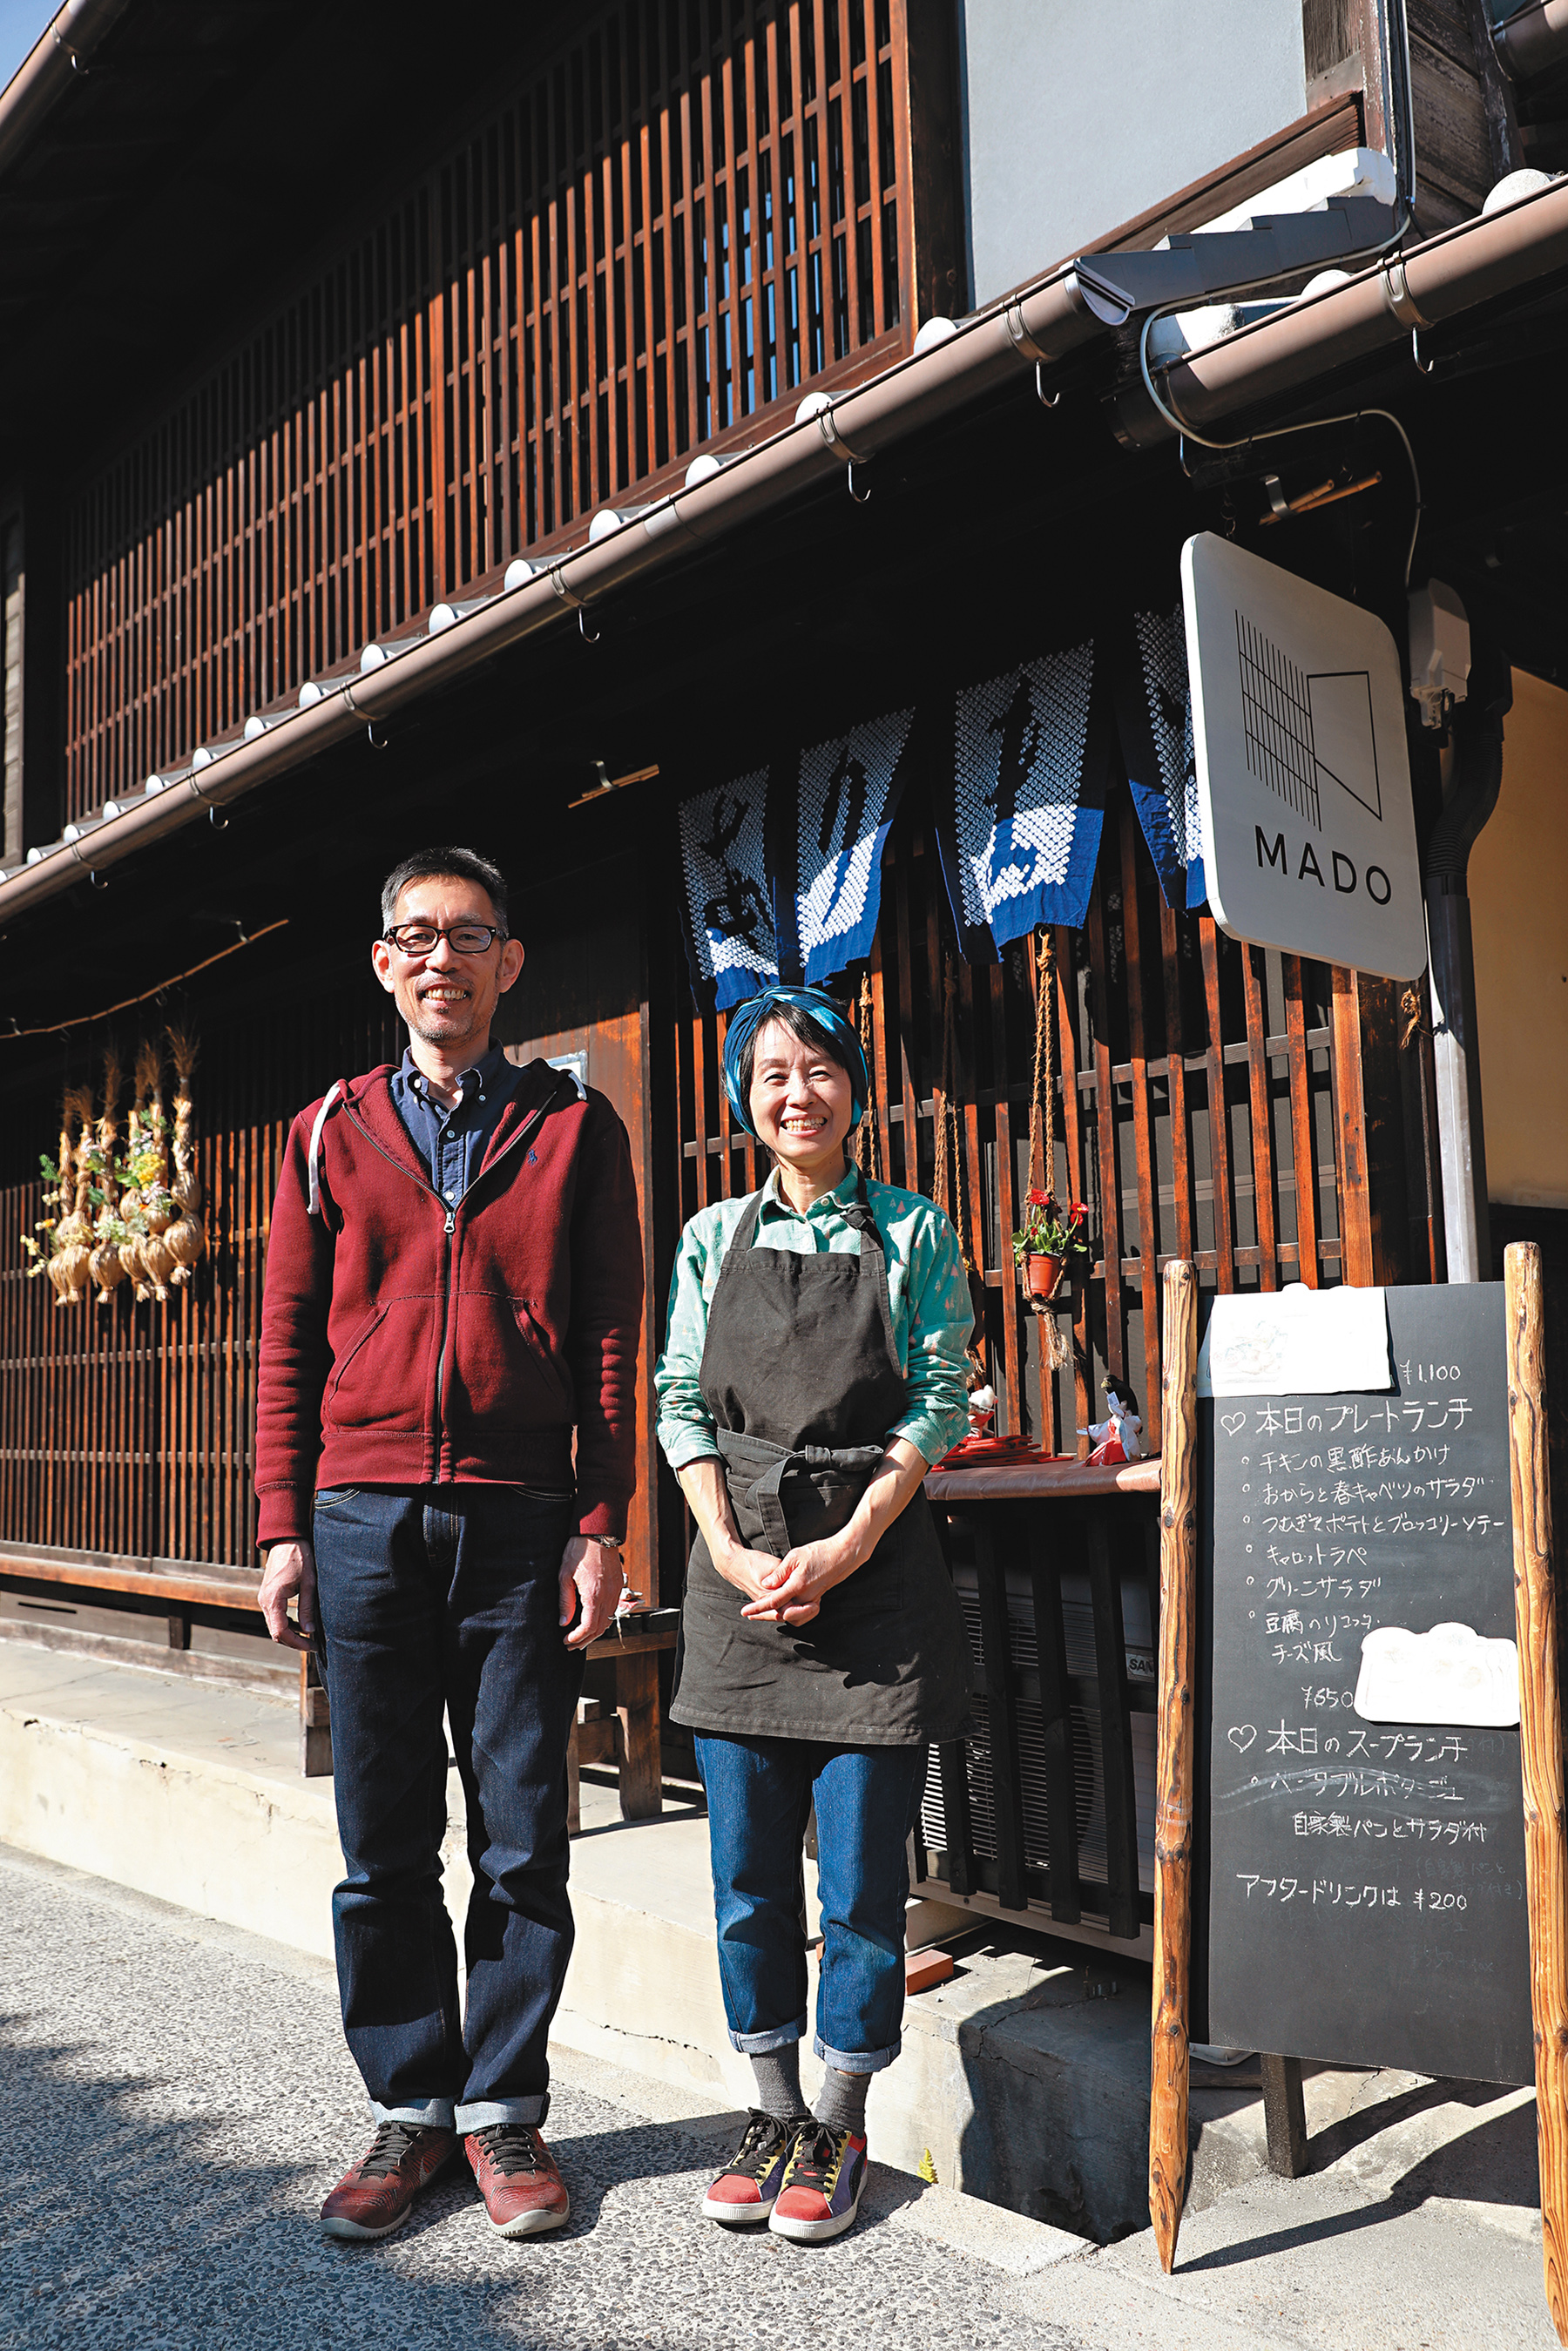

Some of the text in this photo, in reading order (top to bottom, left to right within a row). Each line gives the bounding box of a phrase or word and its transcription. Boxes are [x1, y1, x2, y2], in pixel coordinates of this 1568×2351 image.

[1254, 824, 1392, 905] MADO
[1255, 1398, 1473, 1437] 本日のプレートランチ
[1271, 1640, 1342, 1665] チーズ風
[1301, 1686, 1354, 1710] ¥650
[1266, 1719, 1469, 1762] 本日のスープランチ
[1236, 1874, 1468, 1912] アフタードリンクは ¥200
